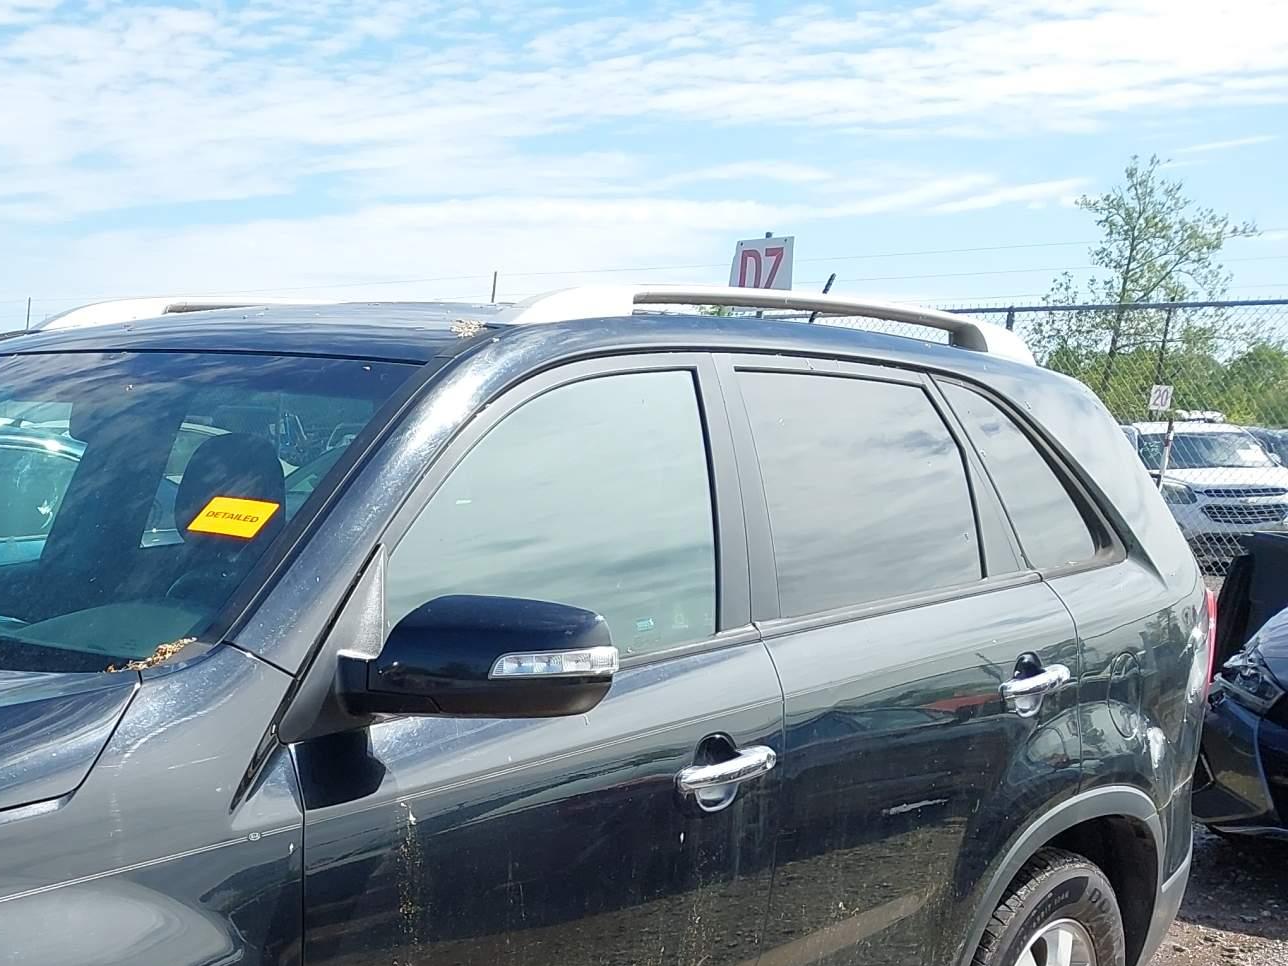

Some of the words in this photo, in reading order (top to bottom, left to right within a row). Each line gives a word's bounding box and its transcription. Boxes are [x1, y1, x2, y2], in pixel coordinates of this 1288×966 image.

[738, 246, 784, 289] D7
[1152, 389, 1169, 406] 20
[206, 510, 259, 523] DETAILED
